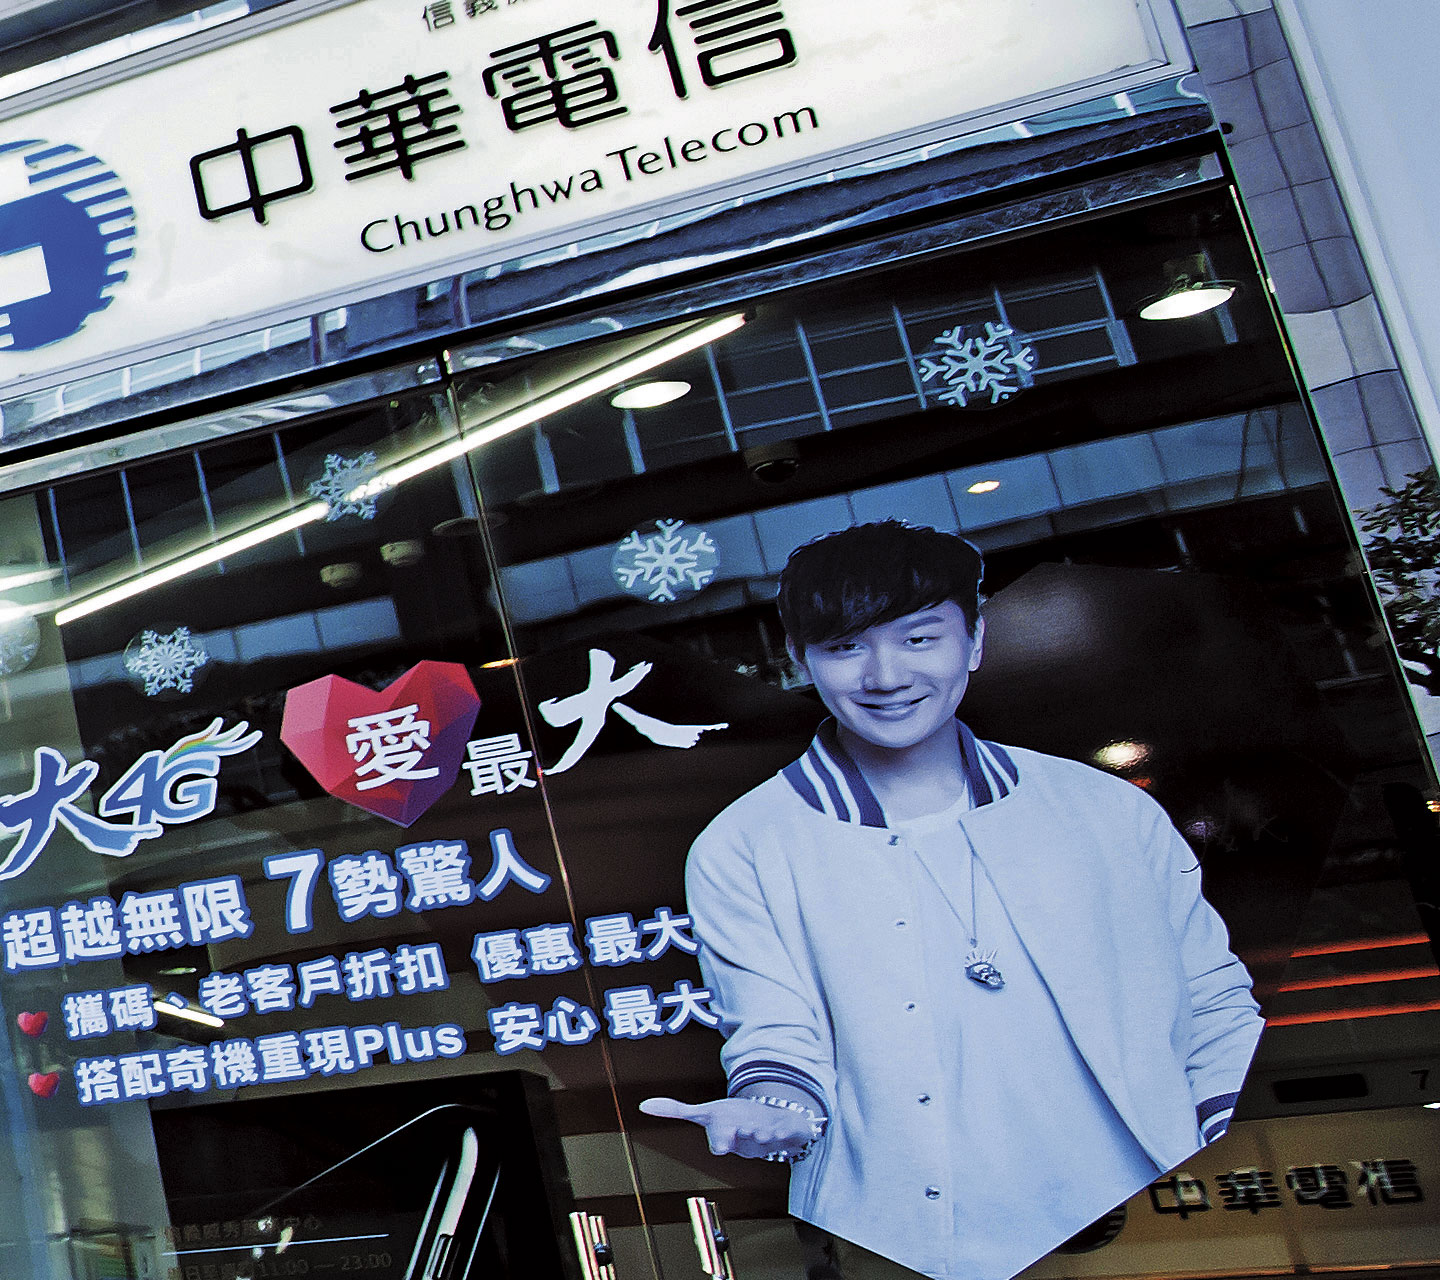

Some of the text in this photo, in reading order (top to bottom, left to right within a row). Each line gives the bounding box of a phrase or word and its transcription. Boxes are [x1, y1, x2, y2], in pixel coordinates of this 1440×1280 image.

[358, 98, 822, 256] Chunghwa Telecom
[2, 827, 550, 973] 超越無限 7勢驚人
[62, 940, 449, 1043] 攜碼、老客戶折扣
[74, 1020, 468, 1108] 搭配奇機重現Plus
